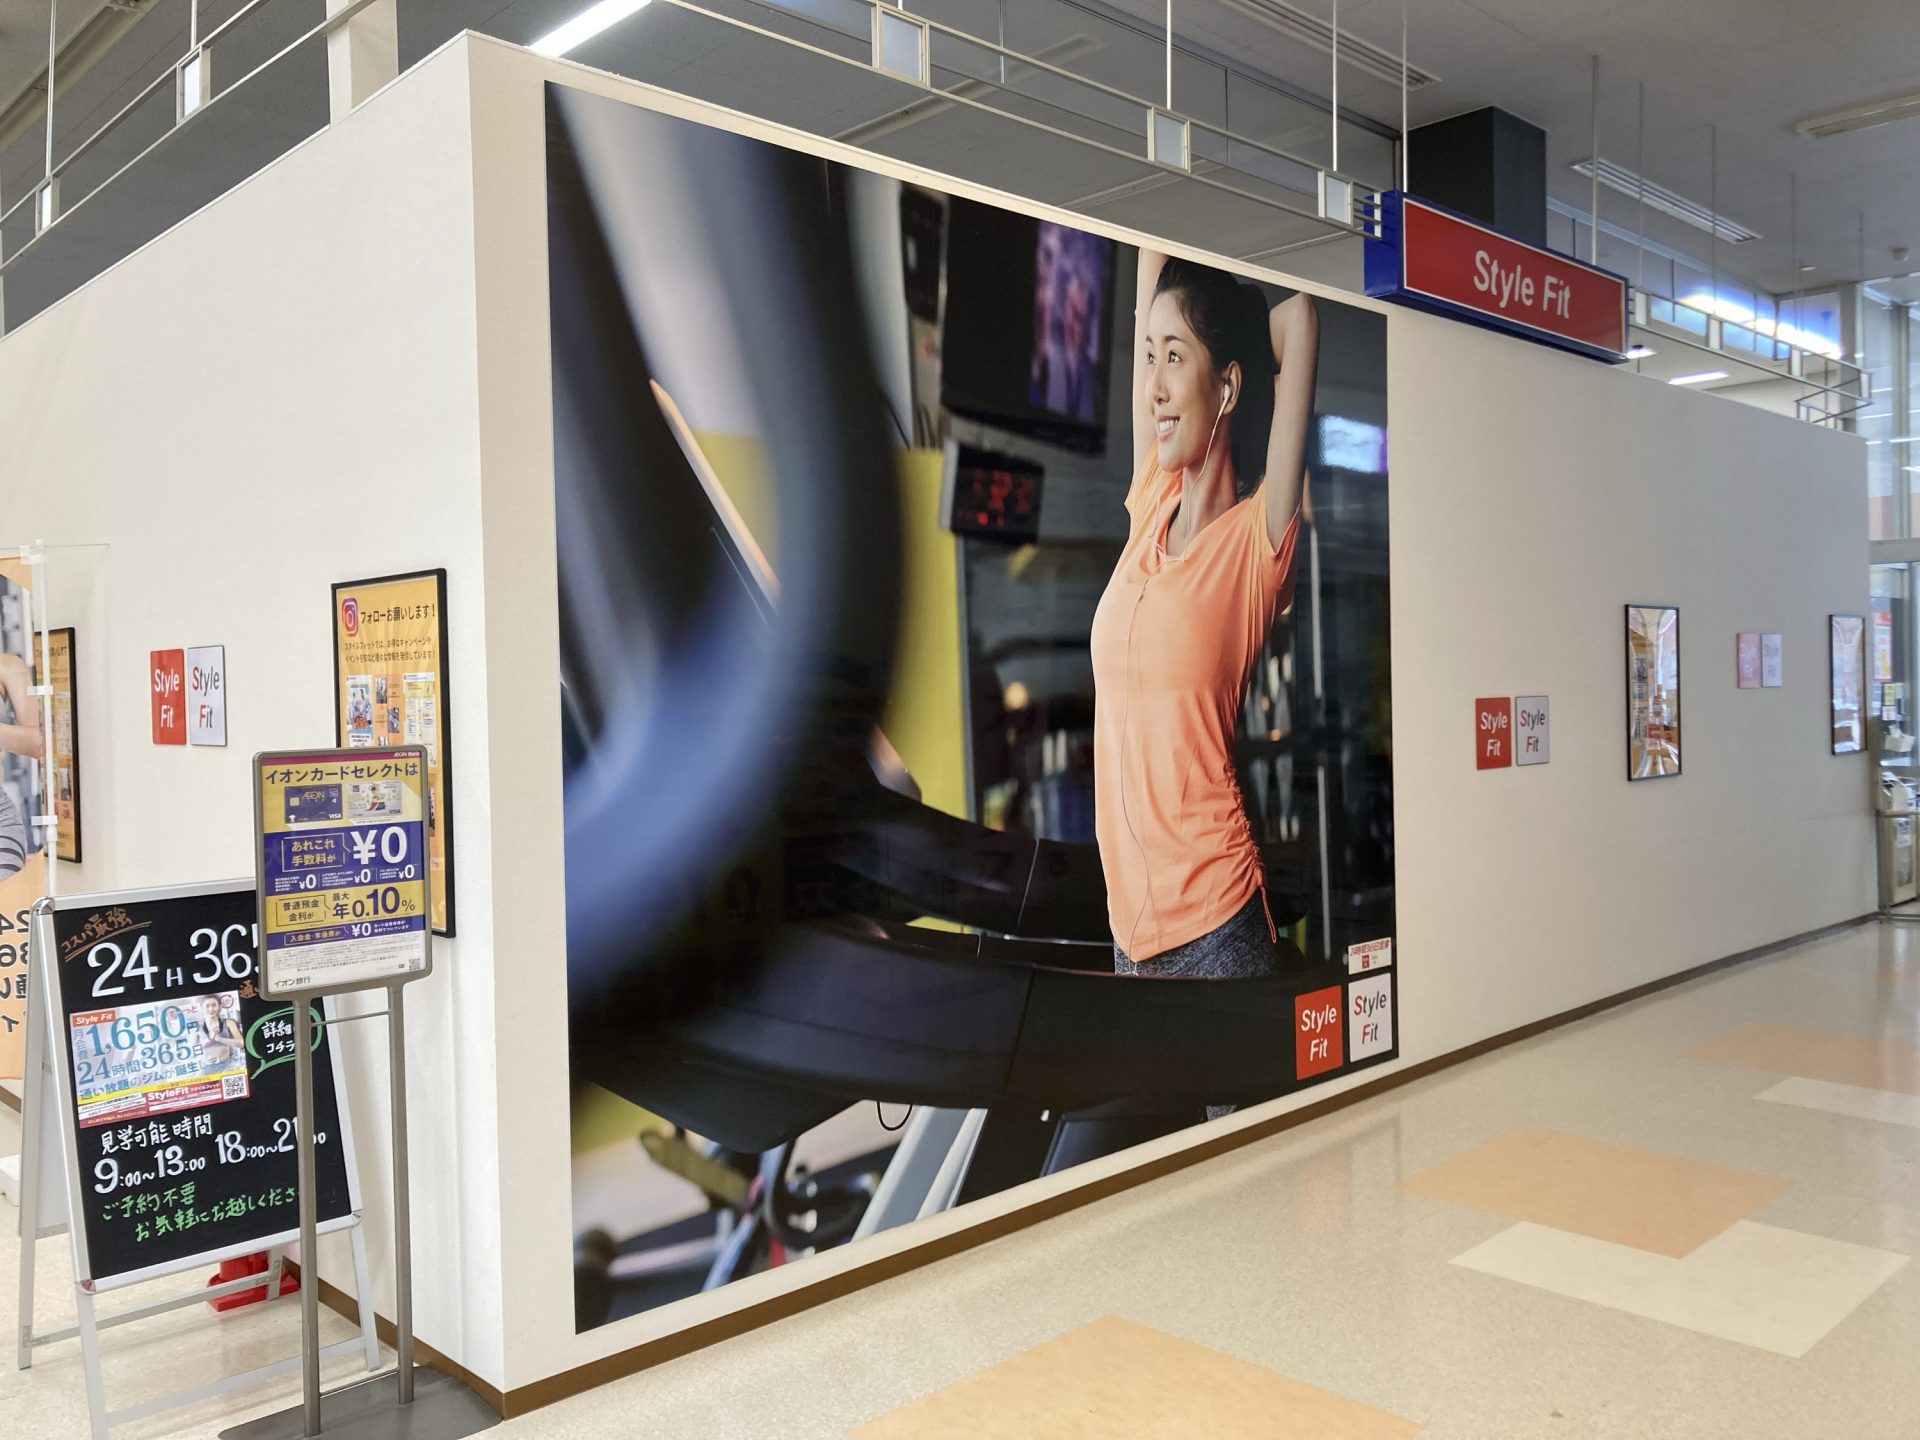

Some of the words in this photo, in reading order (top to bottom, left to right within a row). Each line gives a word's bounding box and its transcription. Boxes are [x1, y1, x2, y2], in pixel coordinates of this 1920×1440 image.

[1473, 250, 1535, 309] Style
[1542, 275, 1571, 320] Fit
[154, 668, 180, 698] Style
[192, 666, 220, 697] Style
[160, 704, 174, 729] Fit
[199, 704, 213, 729] Fit
[1480, 711, 1508, 734] Style
[1520, 709, 1546, 731] Style
[1486, 738, 1501, 757] Fit
[1526, 735, 1539, 753] Fit
[265, 762, 419, 785] イオンカードセレクトは
[291, 838, 336, 852] あれこれ
[350, 825, 408, 865] ¥0
[291, 853, 337, 866] 手数料が
[299, 874, 317, 890] ¥0
[354, 868, 371, 884] ¥0
[398, 864, 415, 879] ¥0
[332, 892, 350, 902] 最大
[288, 911, 314, 922] 金利が
[351, 922, 372, 937] ¥0
[190, 924, 259, 984] 36
[273, 976, 311, 988] イオン銀行
[1354, 990, 1387, 1018] Style
[76, 1014, 98, 1025] Style
[100, 1013, 113, 1022] Fit
[1301, 1004, 1337, 1034] Style
[1361, 1023, 1379, 1045] Fit
[1309, 1037, 1328, 1061] Fit
[147, 1087, 189, 1100] StyleFit
[101, 1113, 213, 1155] 見学可能時間
[102, 1181, 197, 1221] ご予約不要
[135, 1186, 300, 1242] お気軽にお越しくださ
